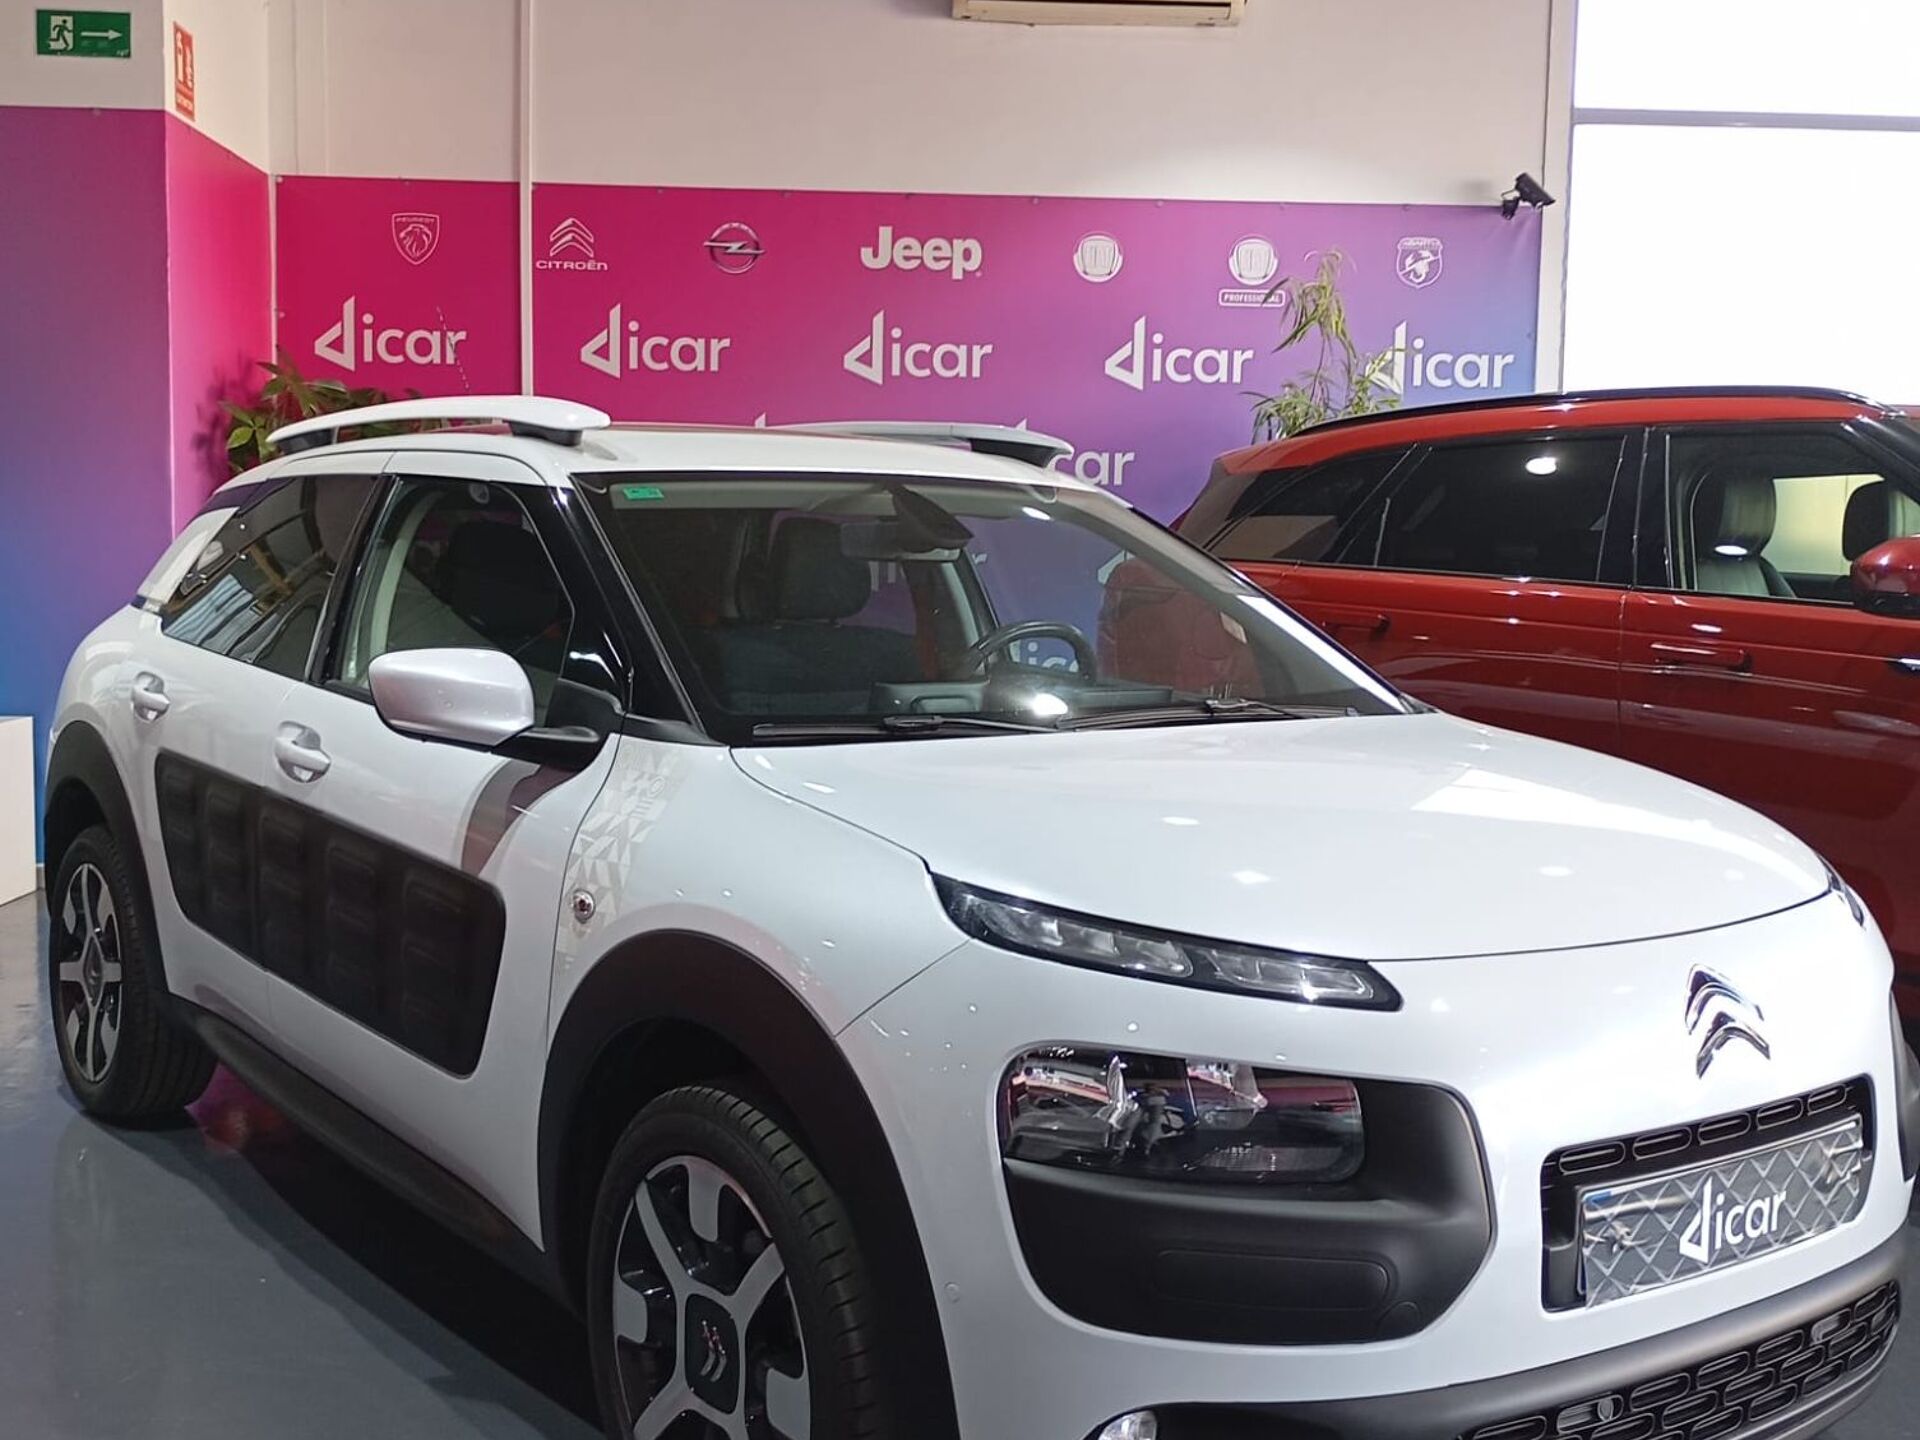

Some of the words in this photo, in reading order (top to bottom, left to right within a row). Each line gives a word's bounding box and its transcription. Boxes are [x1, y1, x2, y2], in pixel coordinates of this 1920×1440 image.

[860, 226, 982, 281] Jeep
[314, 296, 467, 372] dicar
[580, 303, 731, 379] dicar
[843, 310, 993, 386] dicar
[1104, 316, 1254, 391] dicar
[1679, 1175, 1787, 1265] dicar
